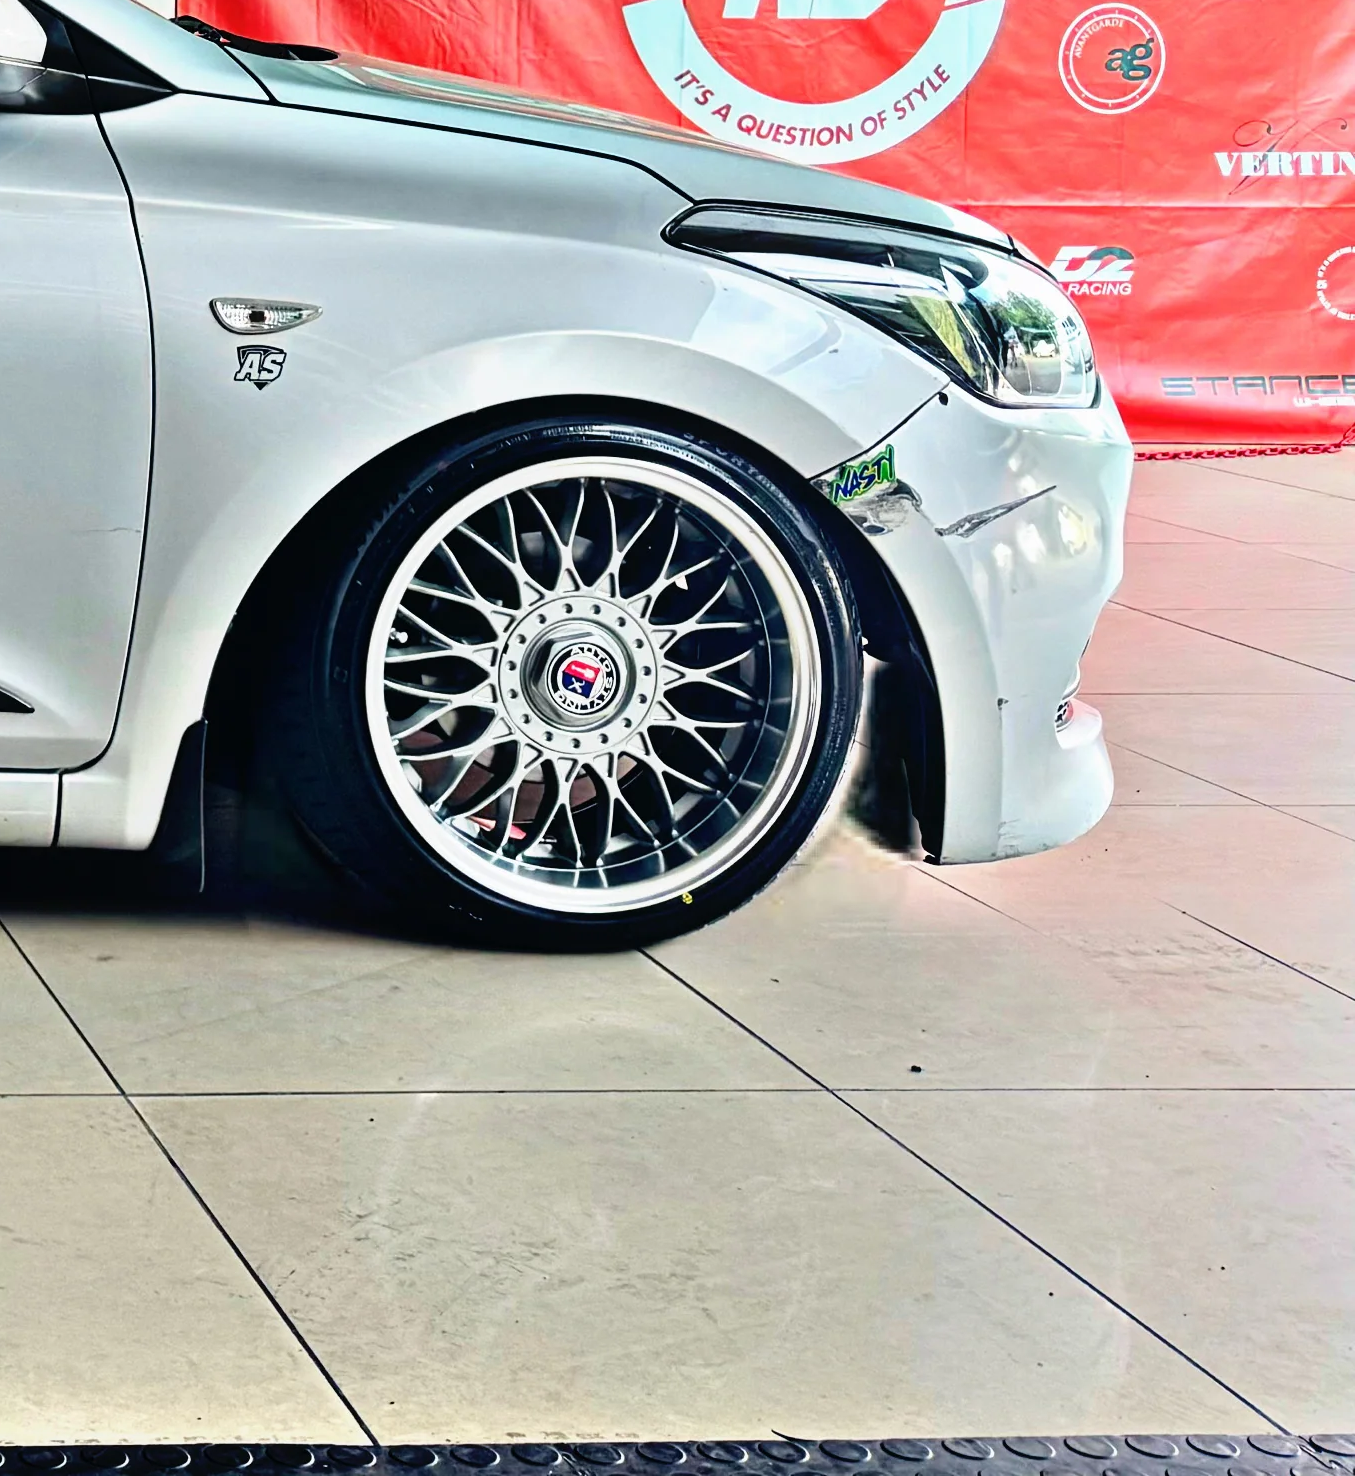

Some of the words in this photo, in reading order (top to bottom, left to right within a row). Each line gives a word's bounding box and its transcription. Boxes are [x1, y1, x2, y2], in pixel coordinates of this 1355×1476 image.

[673, 68, 715, 106] IT'S
[712, 103, 731, 122] A
[737, 114, 854, 146] QUESTION
[860, 114, 889, 137] OF
[894, 64, 952, 121] STYLE
[1213, 151, 1355, 177] VERTIN
[1067, 283, 1132, 296] RACING
[234, 350, 287, 381] AS
[832, 444, 895, 504] NASTY
[570, 645, 611, 673] AUTO
